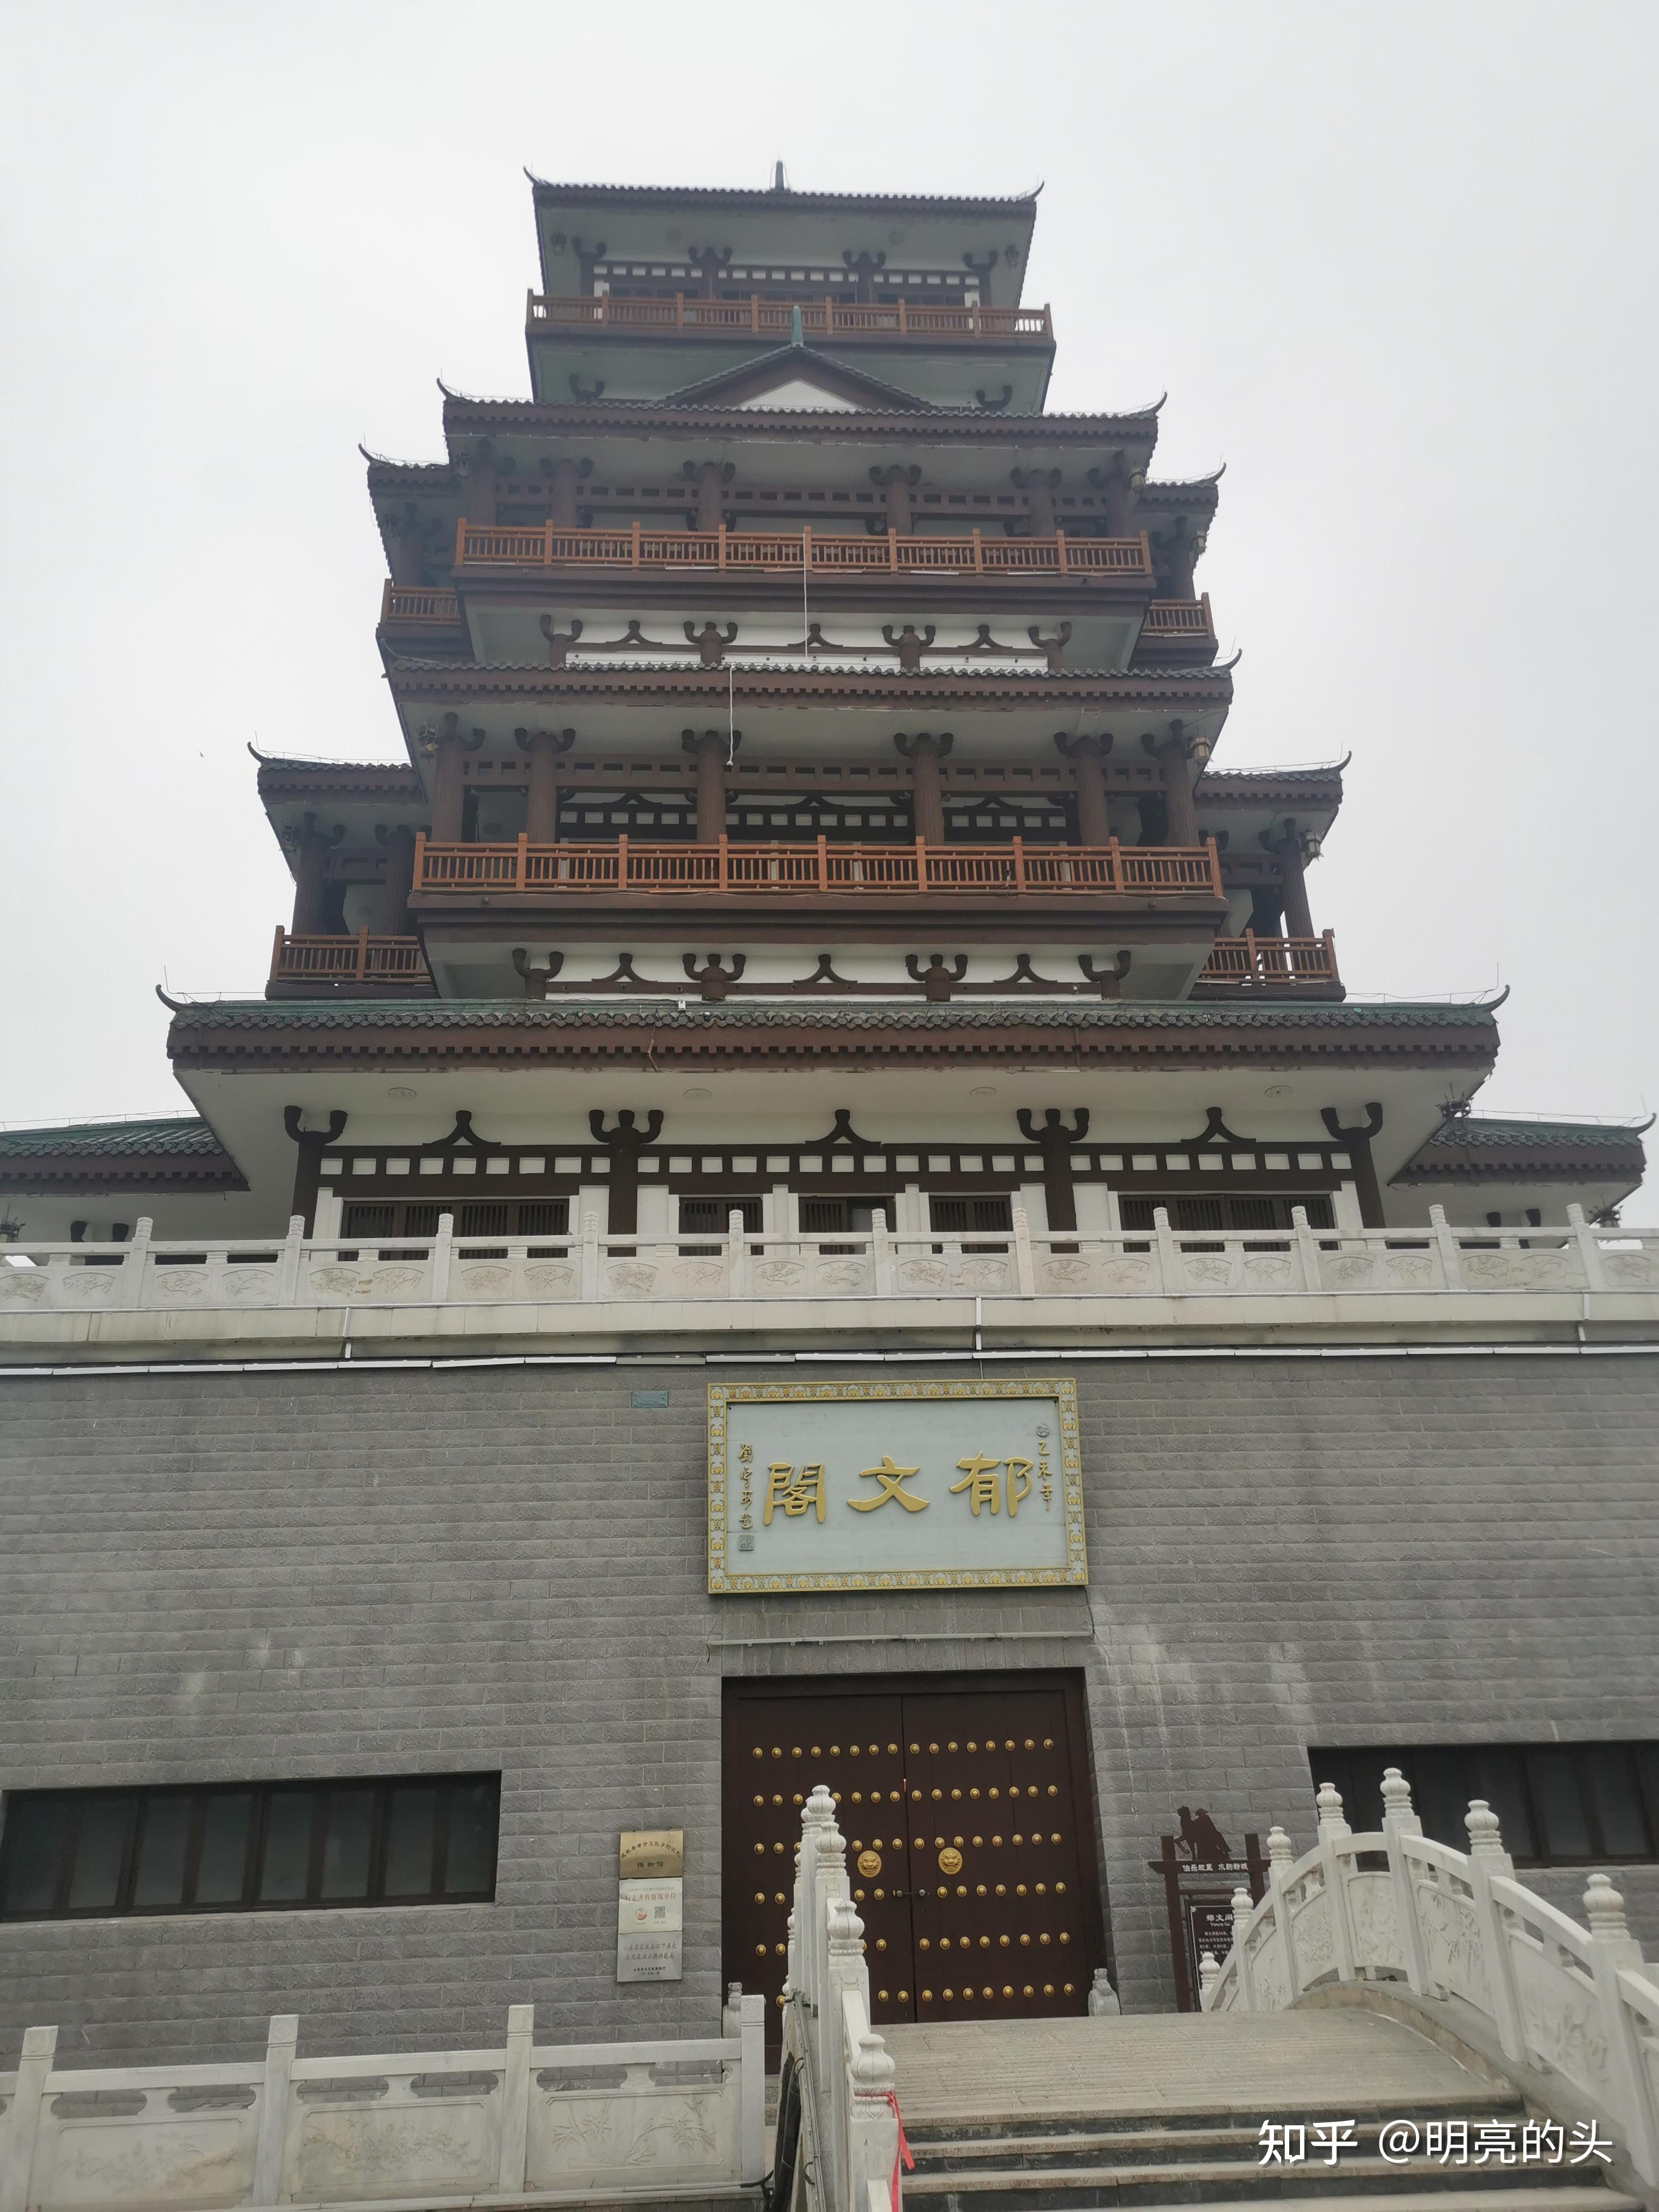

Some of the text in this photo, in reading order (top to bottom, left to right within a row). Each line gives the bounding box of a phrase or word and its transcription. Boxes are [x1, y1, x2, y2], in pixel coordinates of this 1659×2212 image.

[1037, 1440, 1053, 1512] 乙未年
[1182, 1863, 1213, 1872] 伯乐故里
